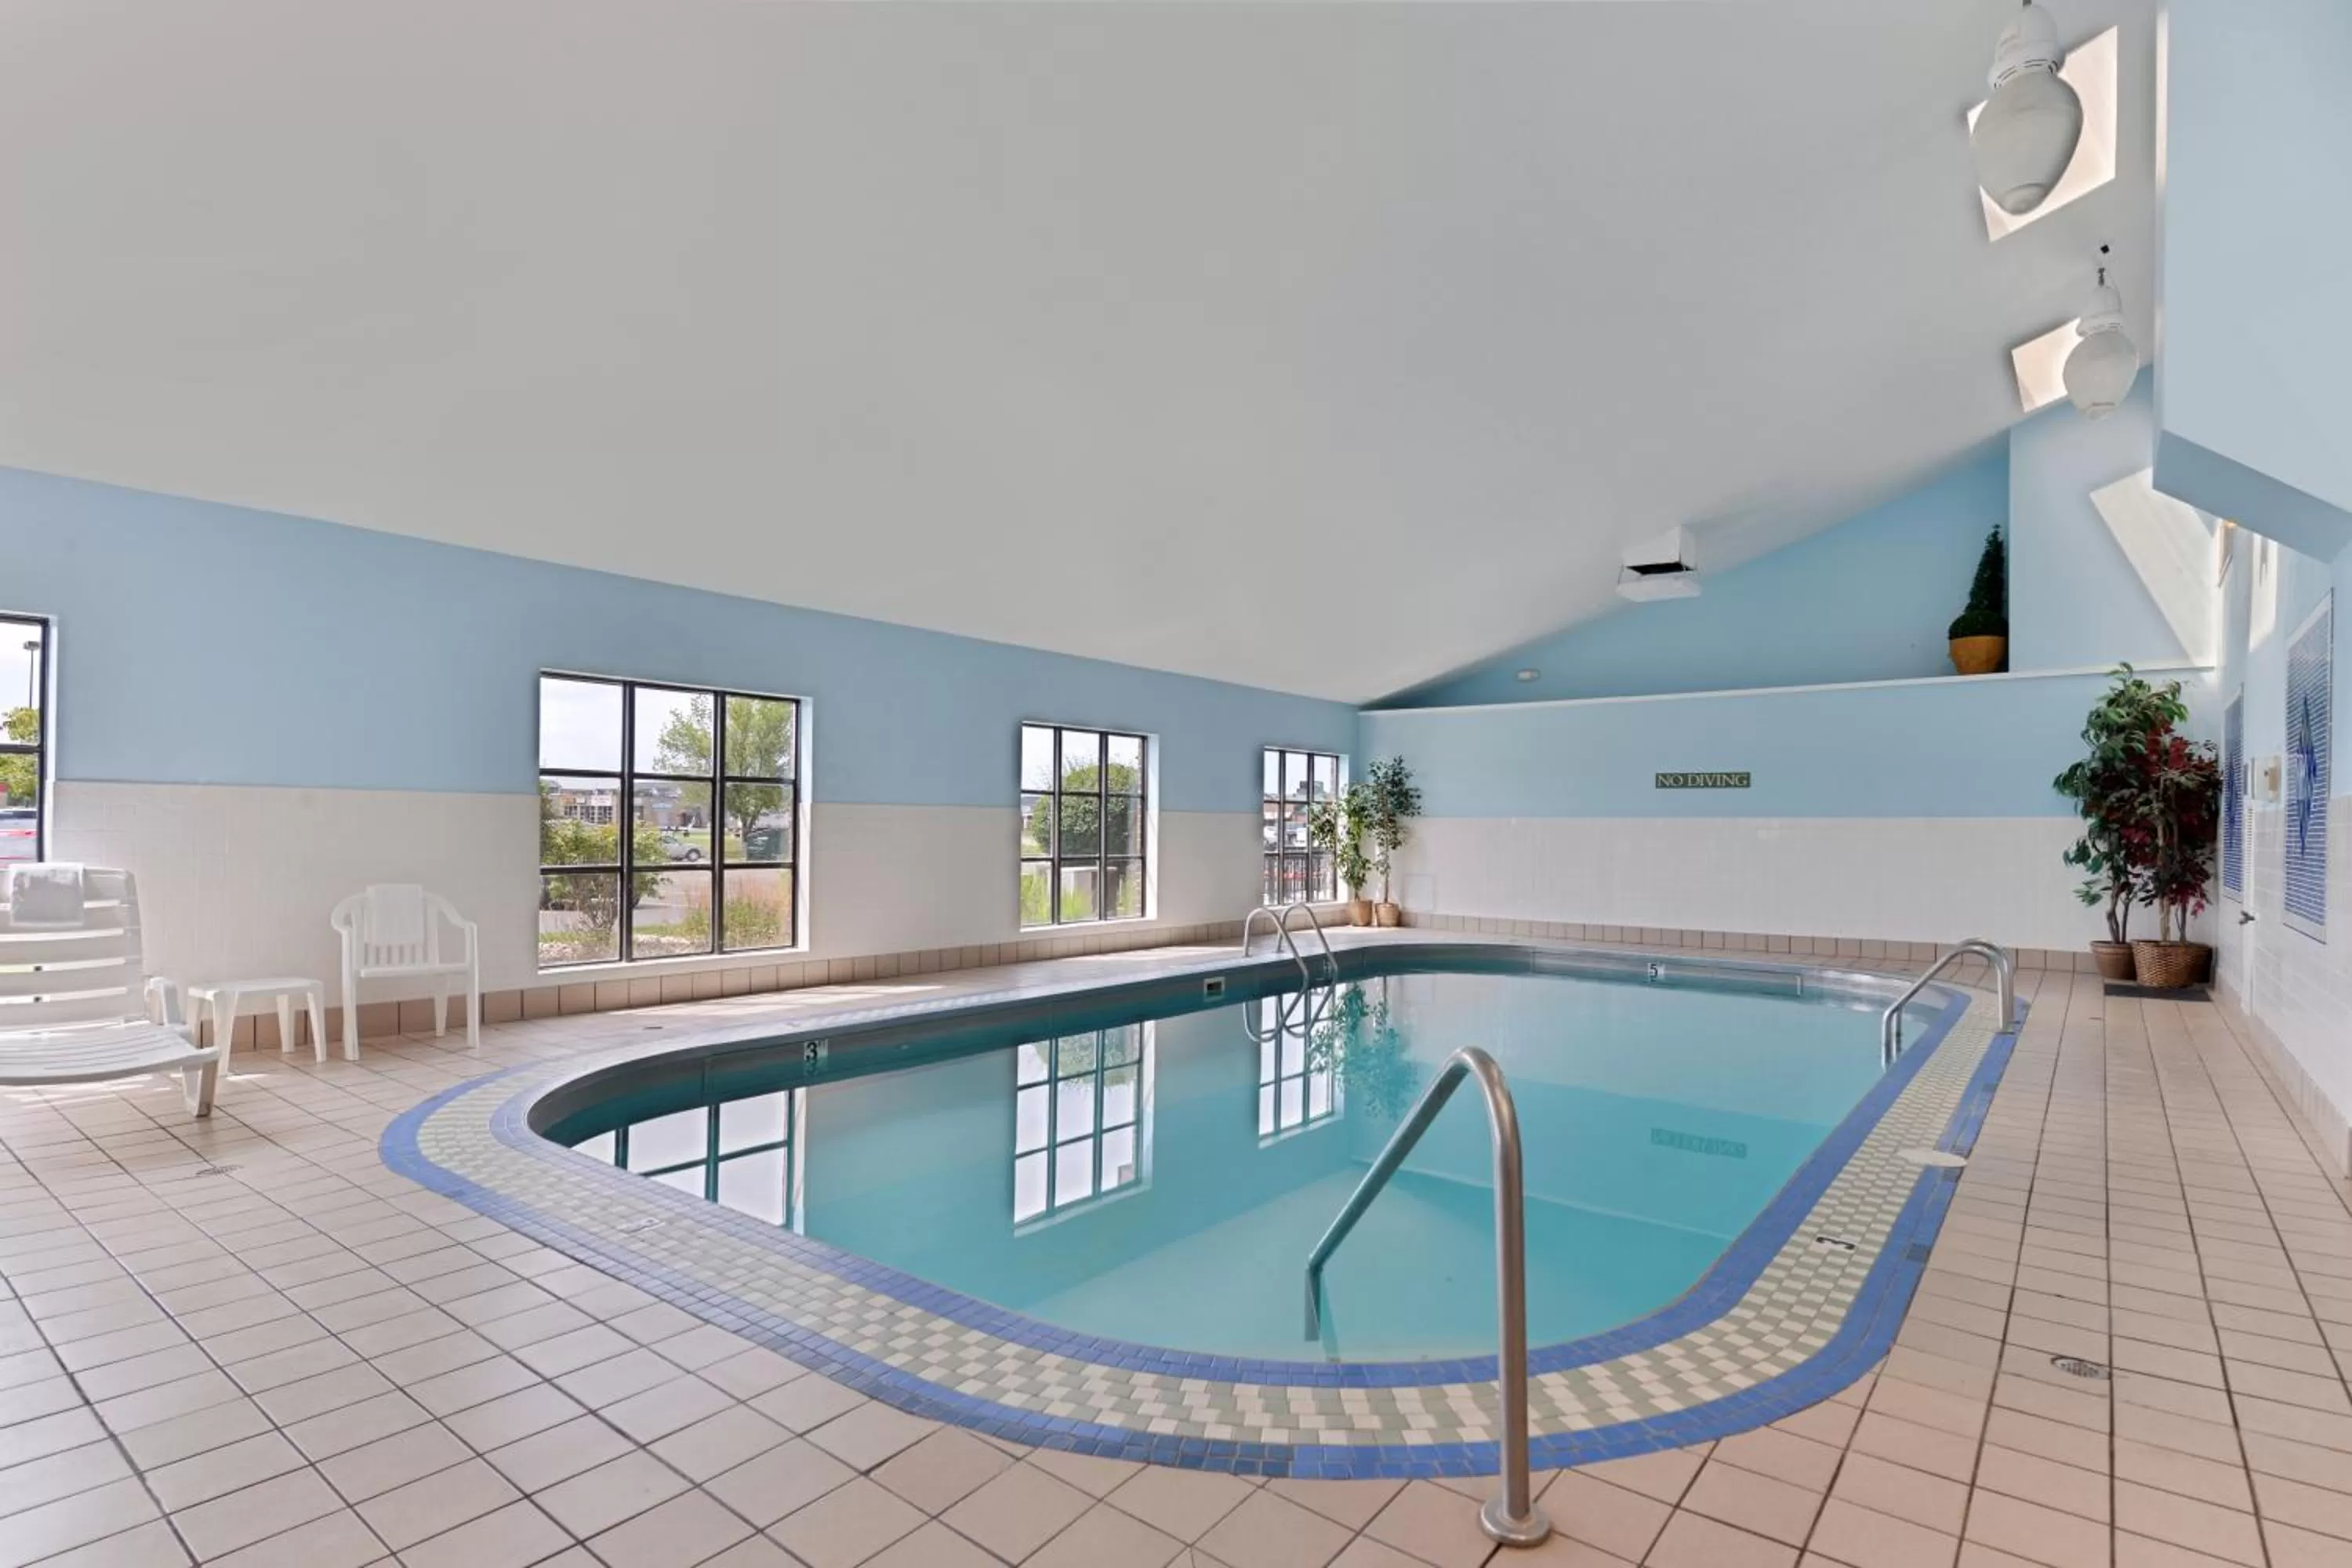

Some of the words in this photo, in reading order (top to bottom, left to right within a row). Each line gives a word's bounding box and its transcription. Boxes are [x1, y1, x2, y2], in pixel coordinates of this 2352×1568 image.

[1657, 774, 1683, 786] NO
[1687, 774, 1748, 786] DIVING
[1650, 964, 1658, 978] 5
[806, 1041, 818, 1062] 3
